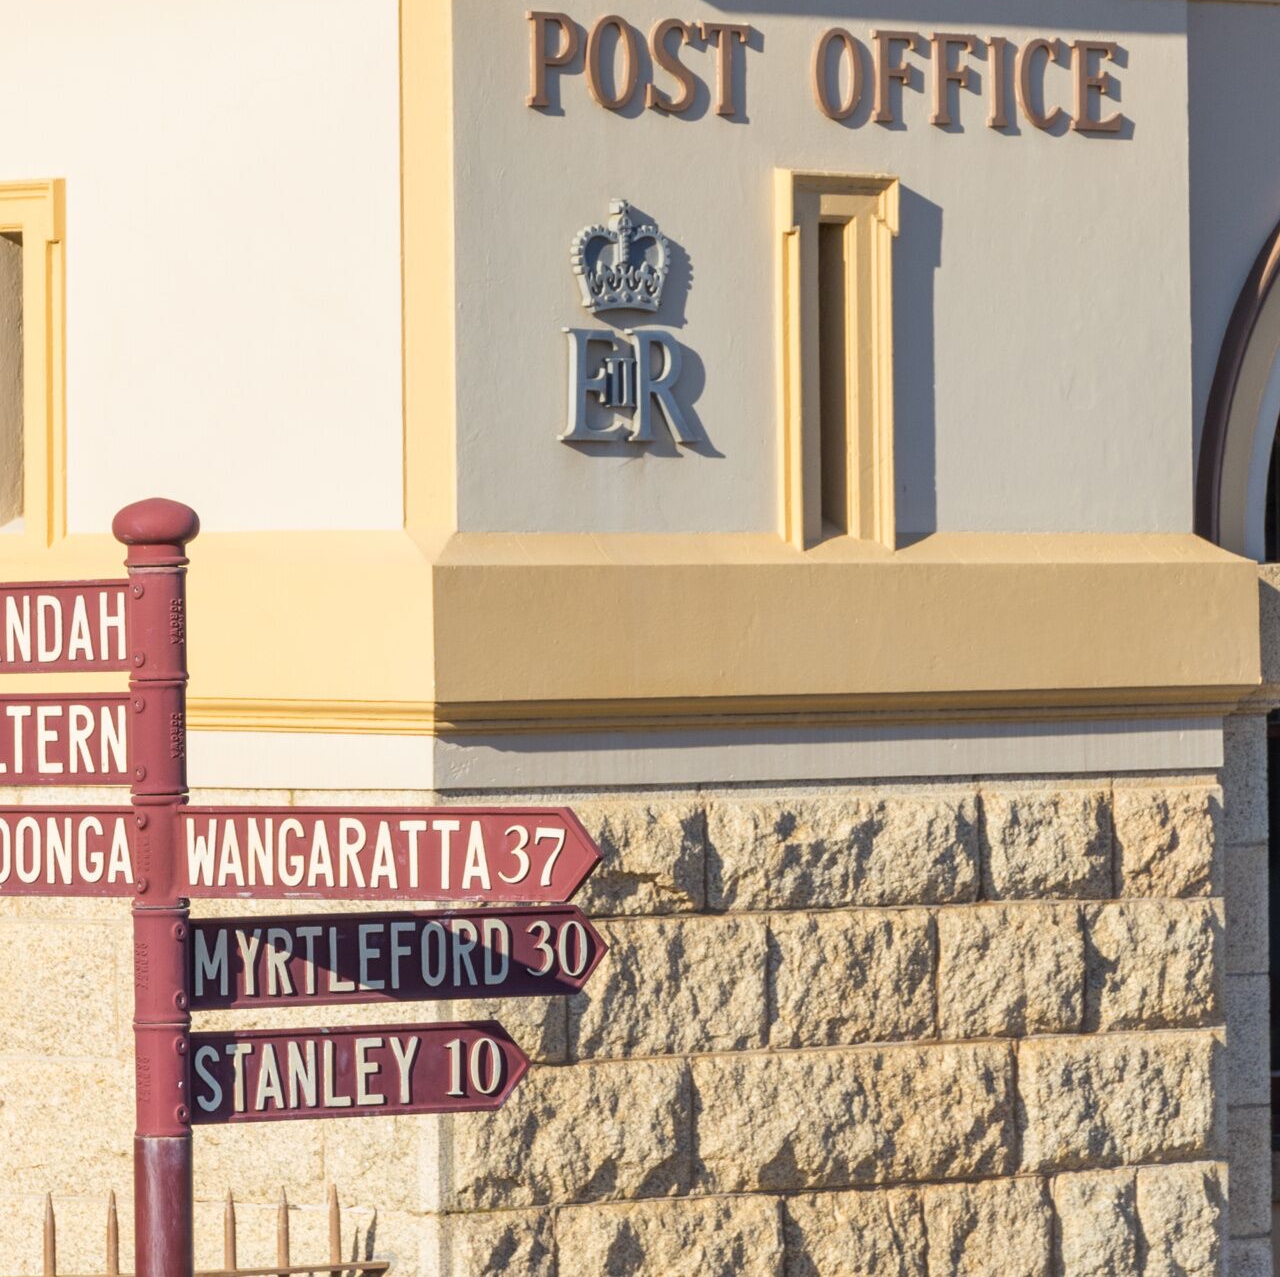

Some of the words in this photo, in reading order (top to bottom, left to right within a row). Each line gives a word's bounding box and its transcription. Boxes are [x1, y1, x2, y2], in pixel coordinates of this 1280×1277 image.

[525, 10, 750, 117] POST
[812, 27, 1123, 132] OFFICE
[186, 817, 492, 890] WANGARATTA
[497, 824, 567, 886] 37
[194, 919, 510, 997] MYRTLEFORD
[525, 920, 588, 977] 30
[194, 1036, 419, 1112] STANLEY
[444, 1038, 503, 1097] 10
